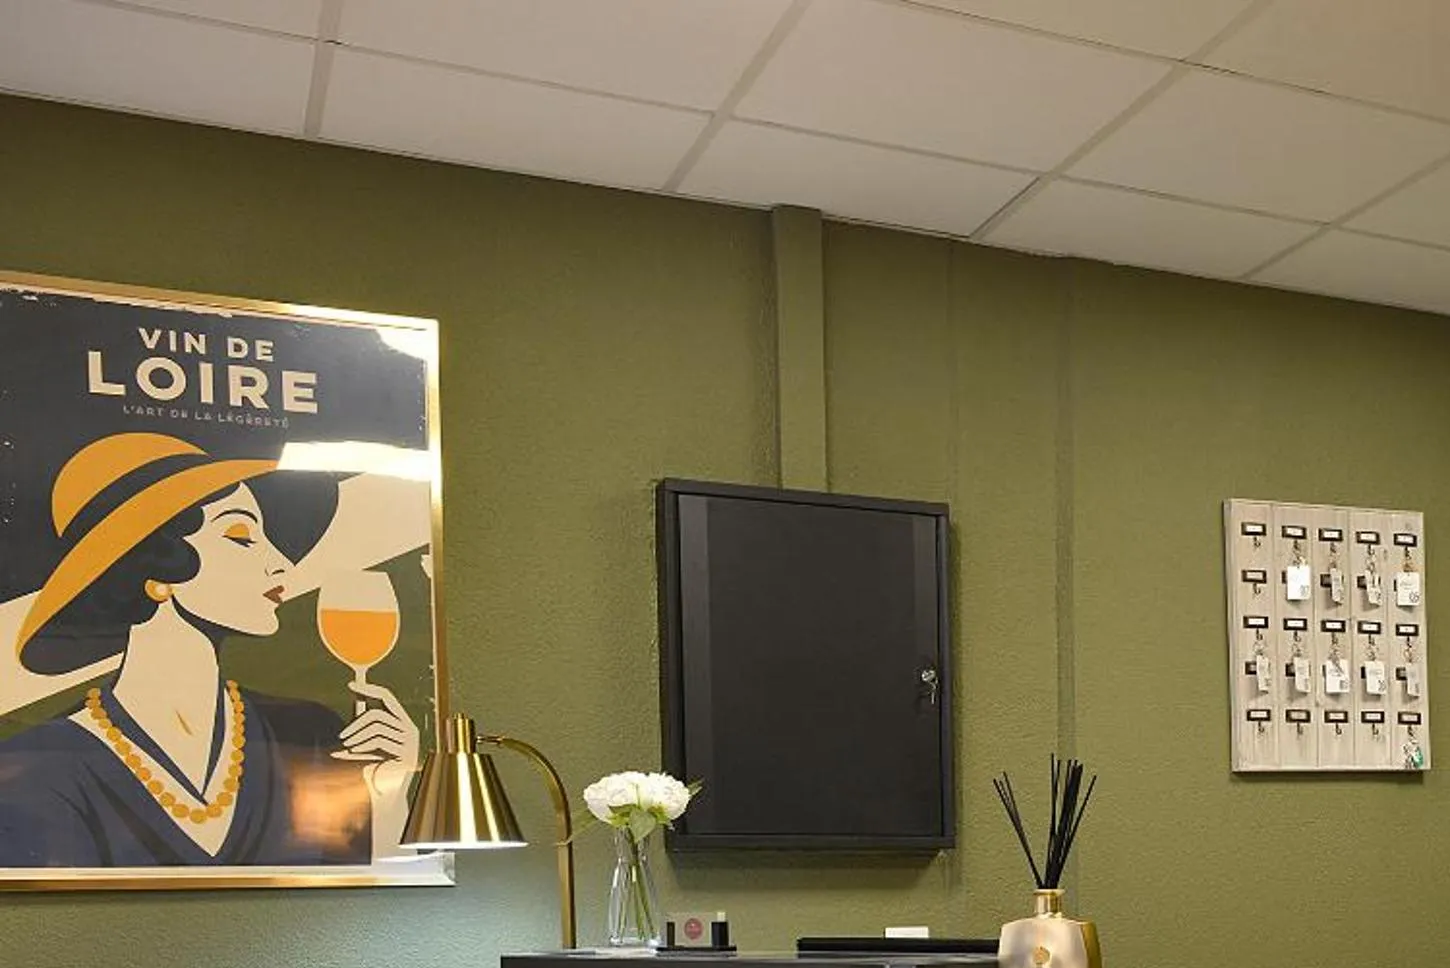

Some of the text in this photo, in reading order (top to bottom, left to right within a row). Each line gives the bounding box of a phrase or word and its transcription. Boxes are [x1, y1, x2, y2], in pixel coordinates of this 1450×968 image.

[138, 327, 275, 362] VIN DE
[88, 350, 319, 415] LOIRE
[194, 411, 213, 421] LA
